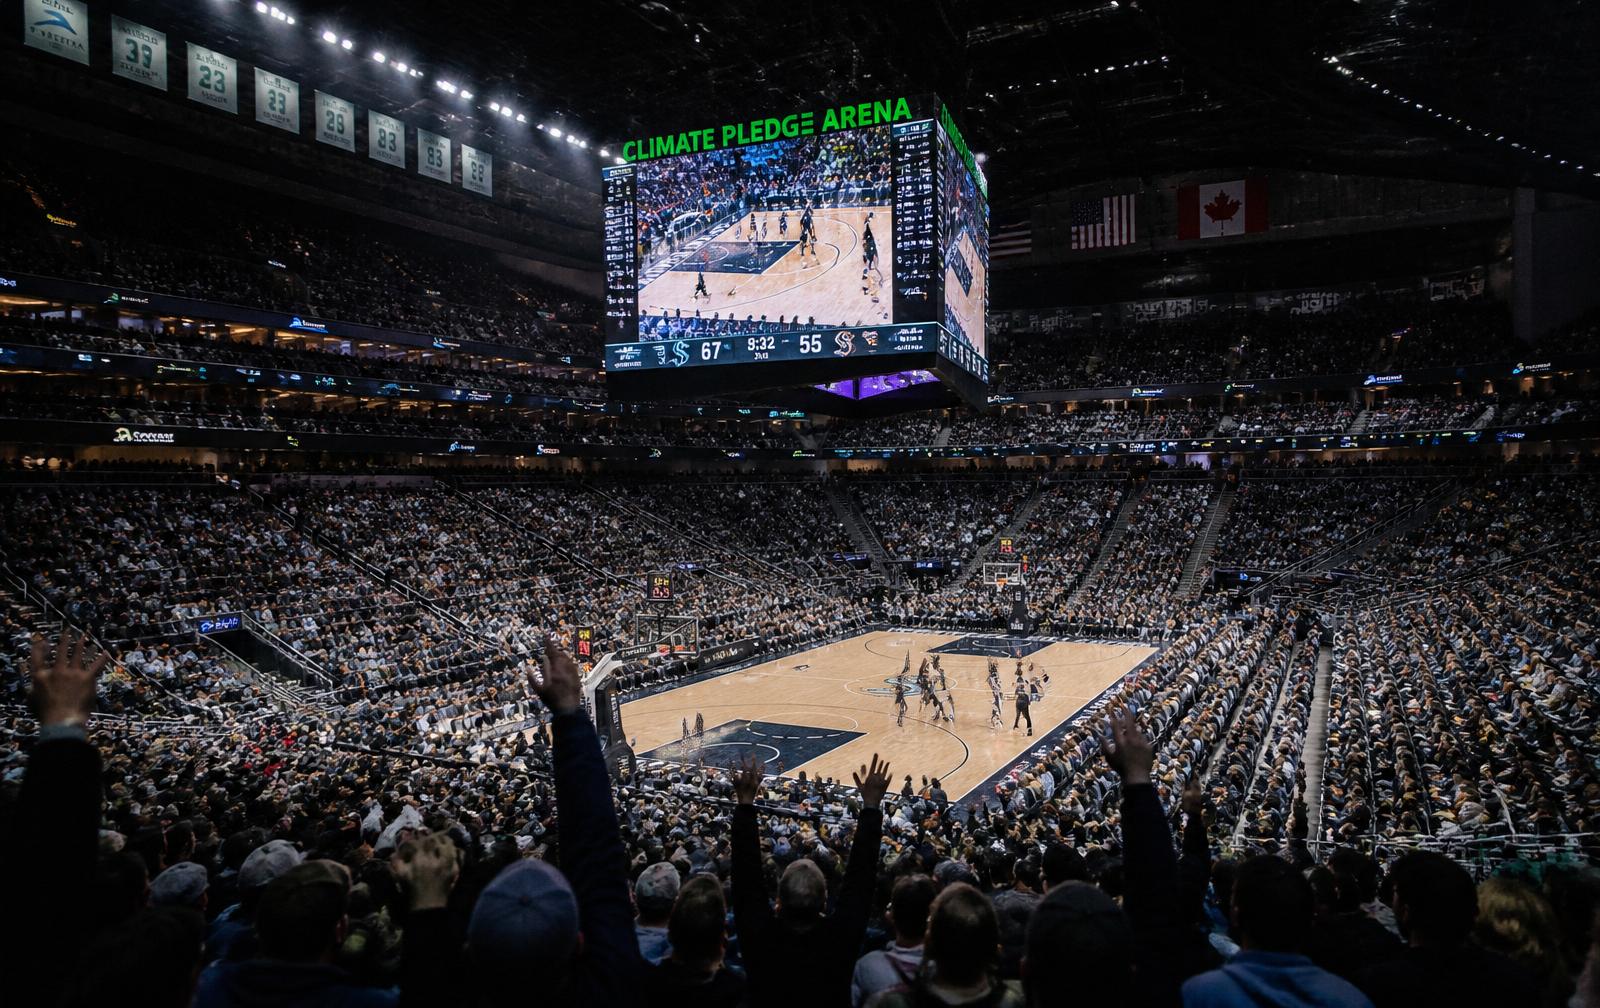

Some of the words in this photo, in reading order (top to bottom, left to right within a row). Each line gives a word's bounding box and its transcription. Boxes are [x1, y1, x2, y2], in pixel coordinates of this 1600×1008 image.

[622, 128, 715, 162] CLIMATE
[721, 112, 814, 146] PLEDGE
[821, 97, 912, 132] ARENA
[701, 341, 721, 361] 67
[747, 336, 776, 351] 9:32
[799, 334, 822, 354] 55
